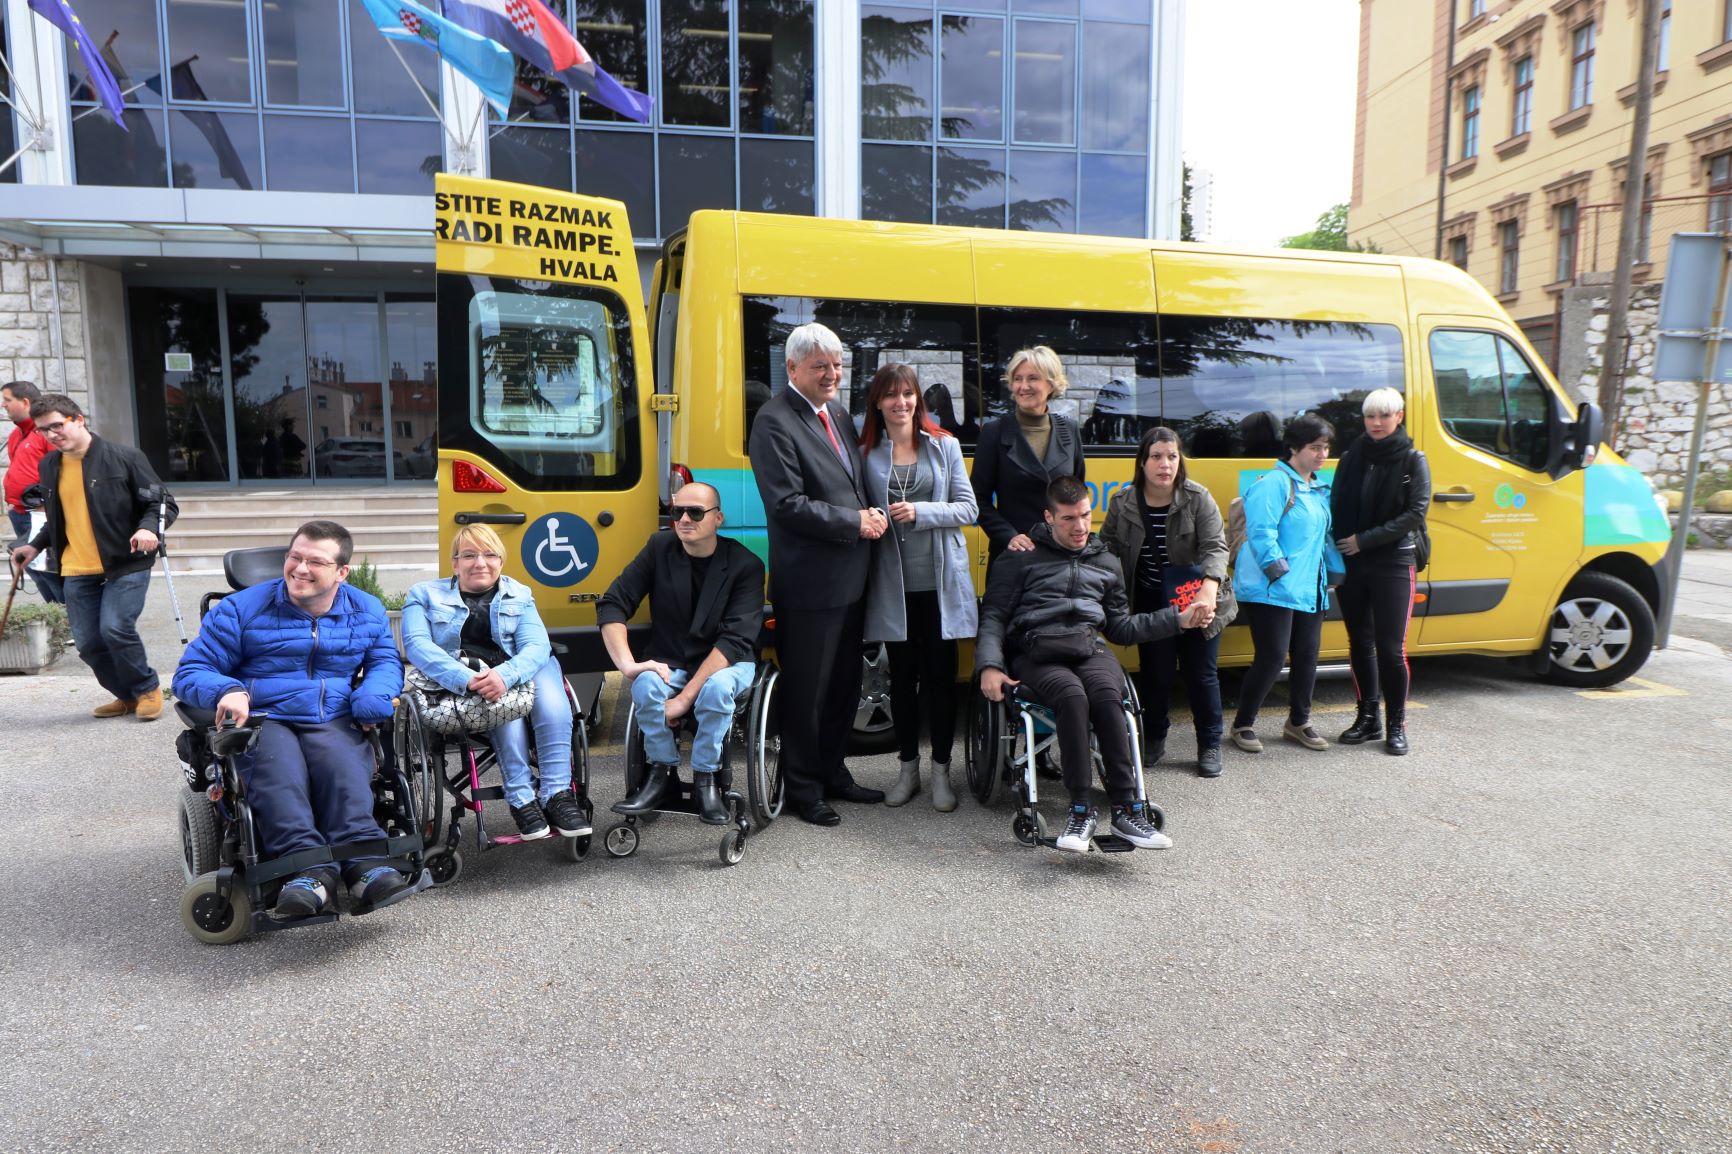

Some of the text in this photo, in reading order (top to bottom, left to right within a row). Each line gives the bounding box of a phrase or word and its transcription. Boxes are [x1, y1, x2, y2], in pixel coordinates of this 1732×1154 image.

[510, 200, 612, 229] RAZMAK
[436, 218, 620, 256] RADI RAMPE.
[540, 258, 618, 282] HVALA
